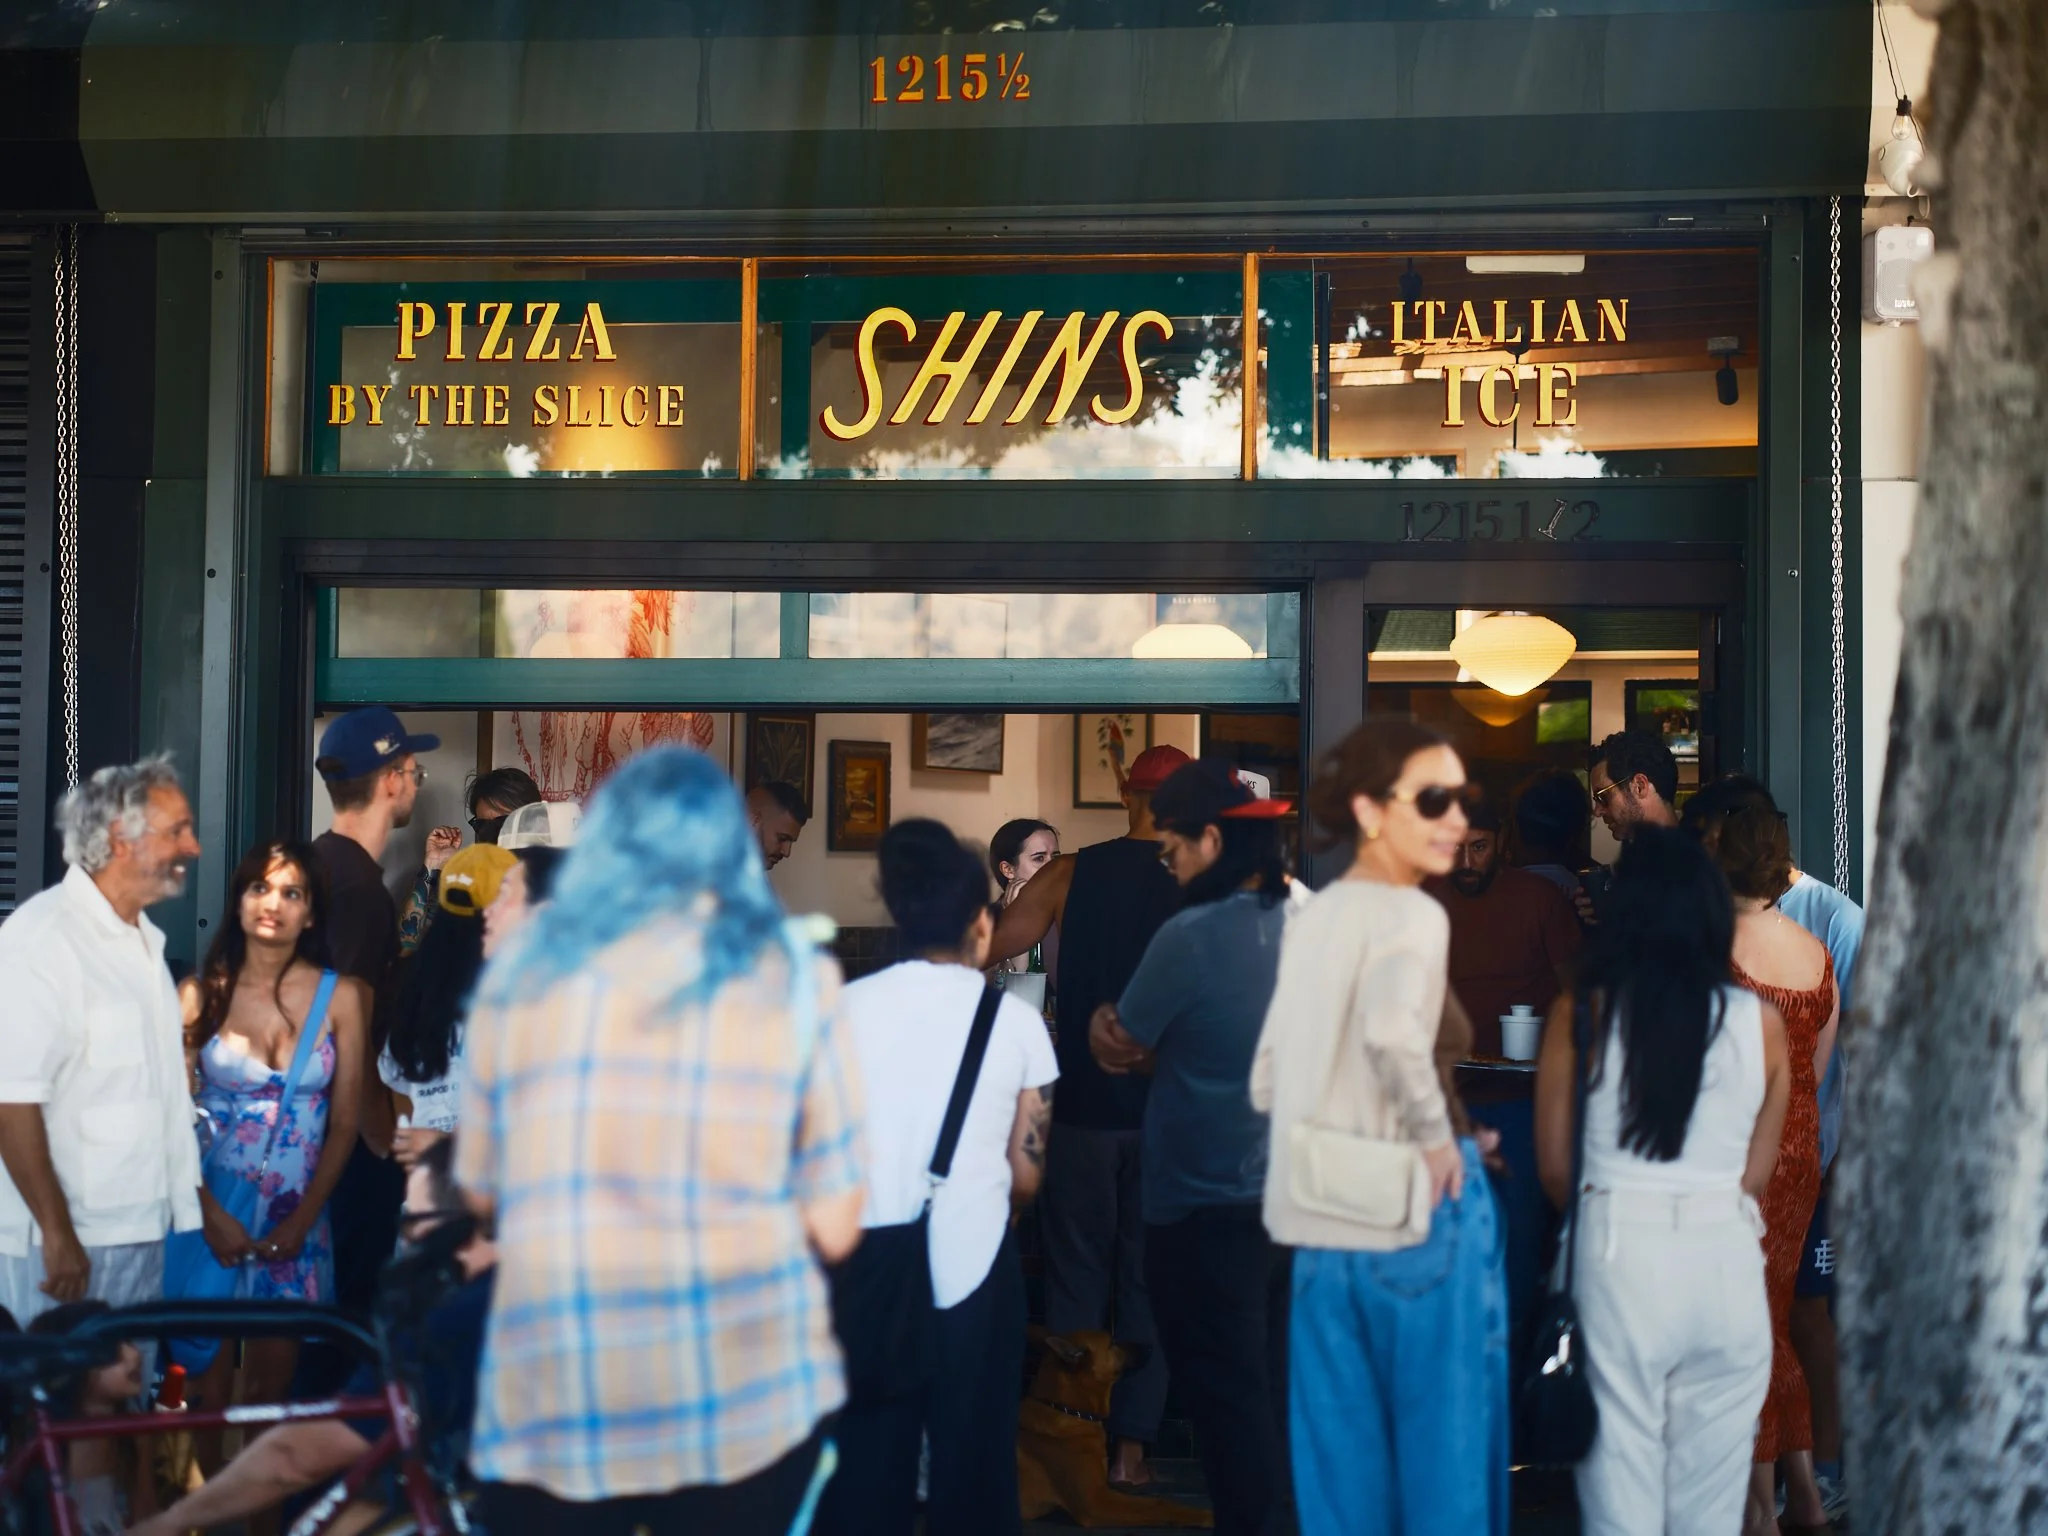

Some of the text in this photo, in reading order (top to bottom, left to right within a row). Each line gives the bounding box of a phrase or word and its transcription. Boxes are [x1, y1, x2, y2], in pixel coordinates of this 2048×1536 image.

[395, 302, 617, 362] PIZZA
[1390, 298, 1629, 345] ITALIAN
[819, 306, 1174, 441] SHINS
[1441, 363, 1578, 428] ICE
[327, 384, 685, 426] BY THE SLICE
